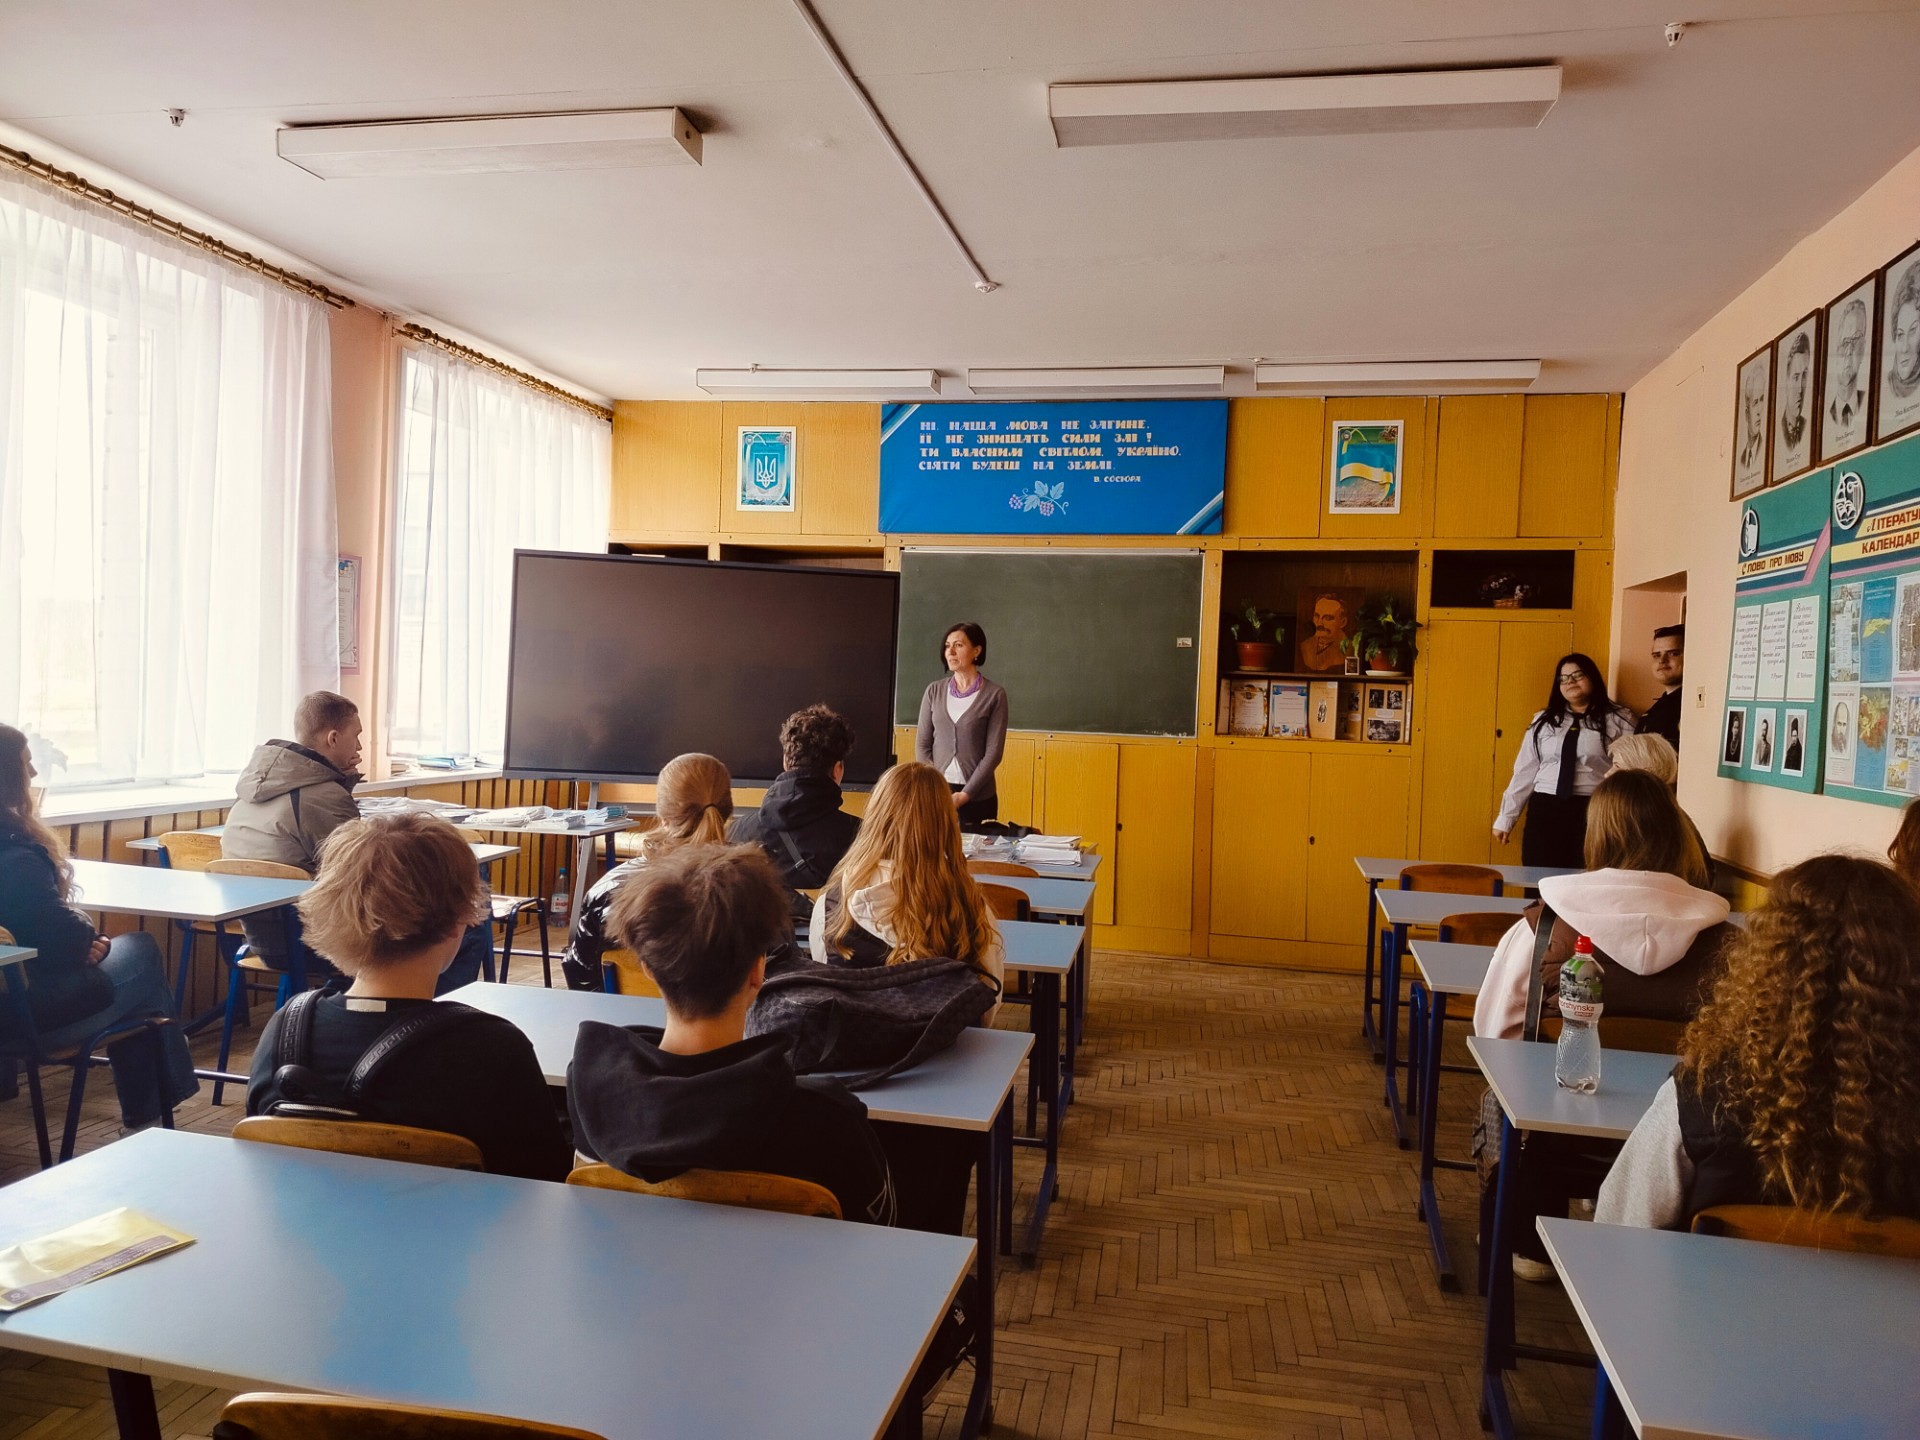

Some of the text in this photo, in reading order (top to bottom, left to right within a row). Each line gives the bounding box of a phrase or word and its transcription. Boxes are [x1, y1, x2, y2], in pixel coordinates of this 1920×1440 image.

[949, 421, 996, 431] НАША
[1006, 420, 1048, 431] МОВА
[1061, 420, 1080, 430] НЕ
[919, 432, 932, 444] ЇЇ
[945, 434, 965, 444] НЕ
[1061, 433, 1101, 443] СИЛИ
[920, 447, 939, 457] ТИ
[951, 447, 1023, 457] ВЛАСНИМ
[918, 461, 961, 471] СІЯТИ
[972, 461, 1020, 471] БУДЕШ
[1033, 461, 1055, 471] НА
[1103, 475, 1142, 483] СОСЮРА
[1866, 508, 1920, 532] ЛІТЕРАТУ
[1861, 531, 1919, 554] КАЛЕНДАР
[1742, 550, 1804, 575] СЛОВО ПРО МОВУ
